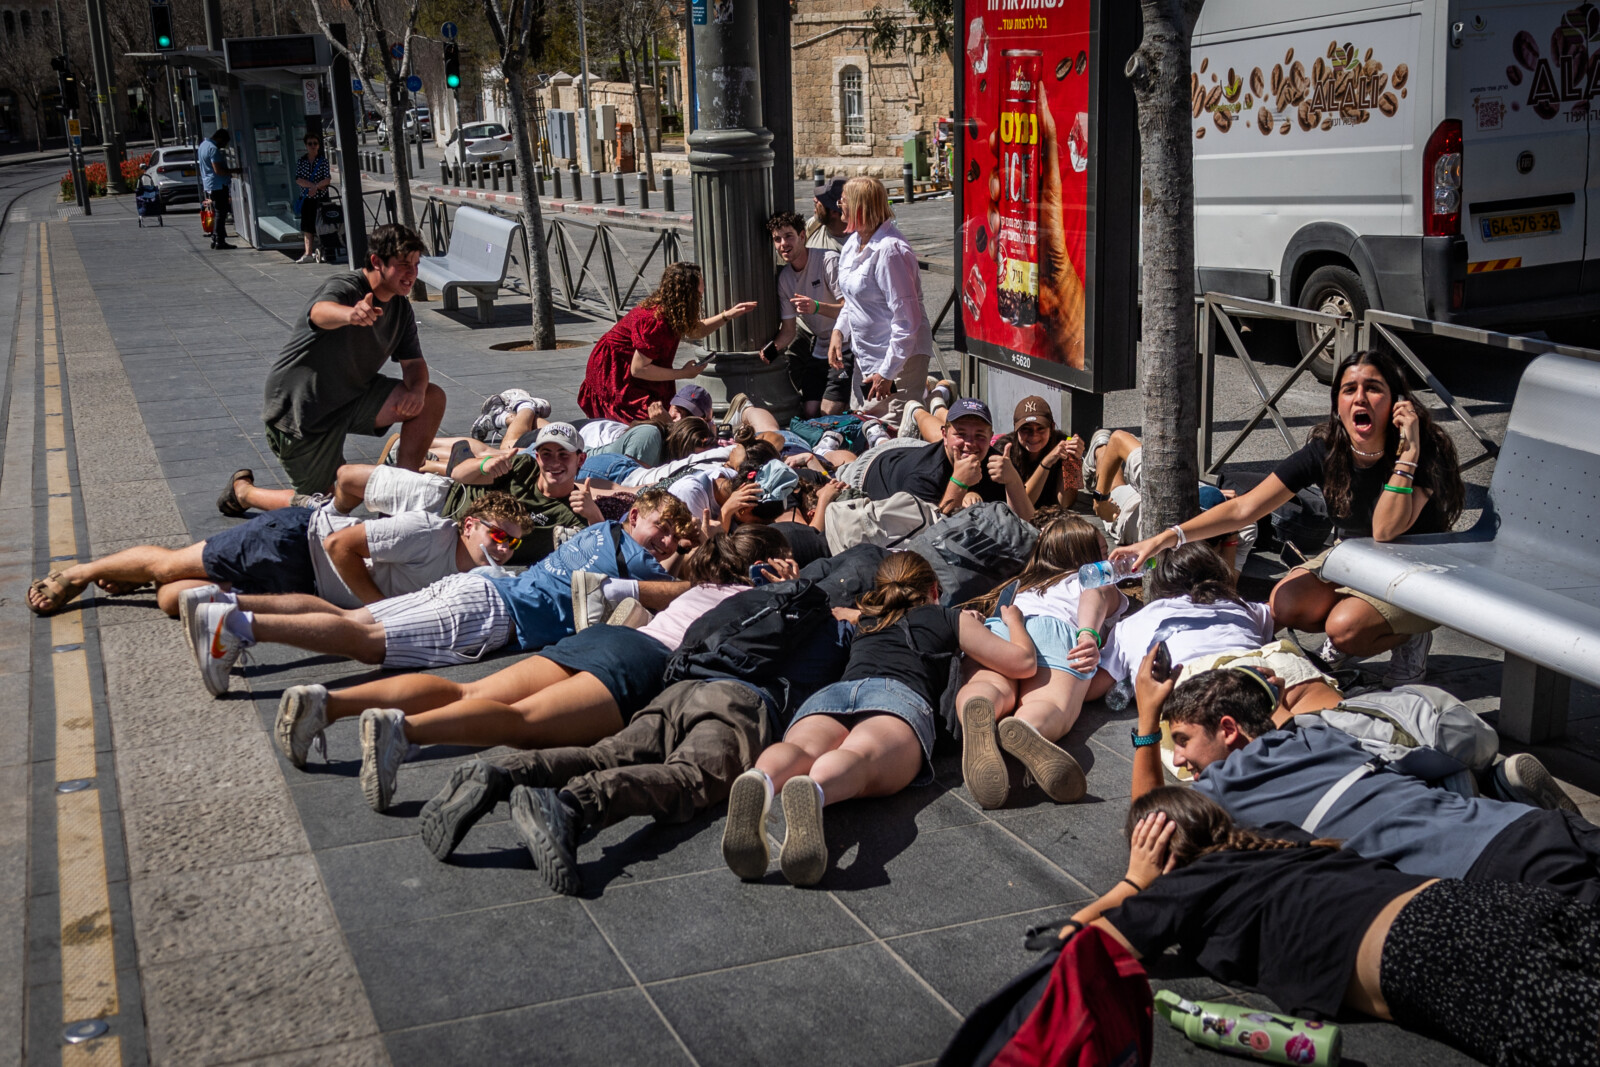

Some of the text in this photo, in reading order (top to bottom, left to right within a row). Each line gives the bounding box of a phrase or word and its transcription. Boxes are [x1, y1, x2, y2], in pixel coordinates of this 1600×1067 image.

[1014, 15, 1034, 30] לרצות
[1035, 14, 1047, 29] בלי
[1309, 75, 1381, 114] ALALI
[1001, 112, 1038, 144] נמס
[1005, 152, 1031, 202] ICE
